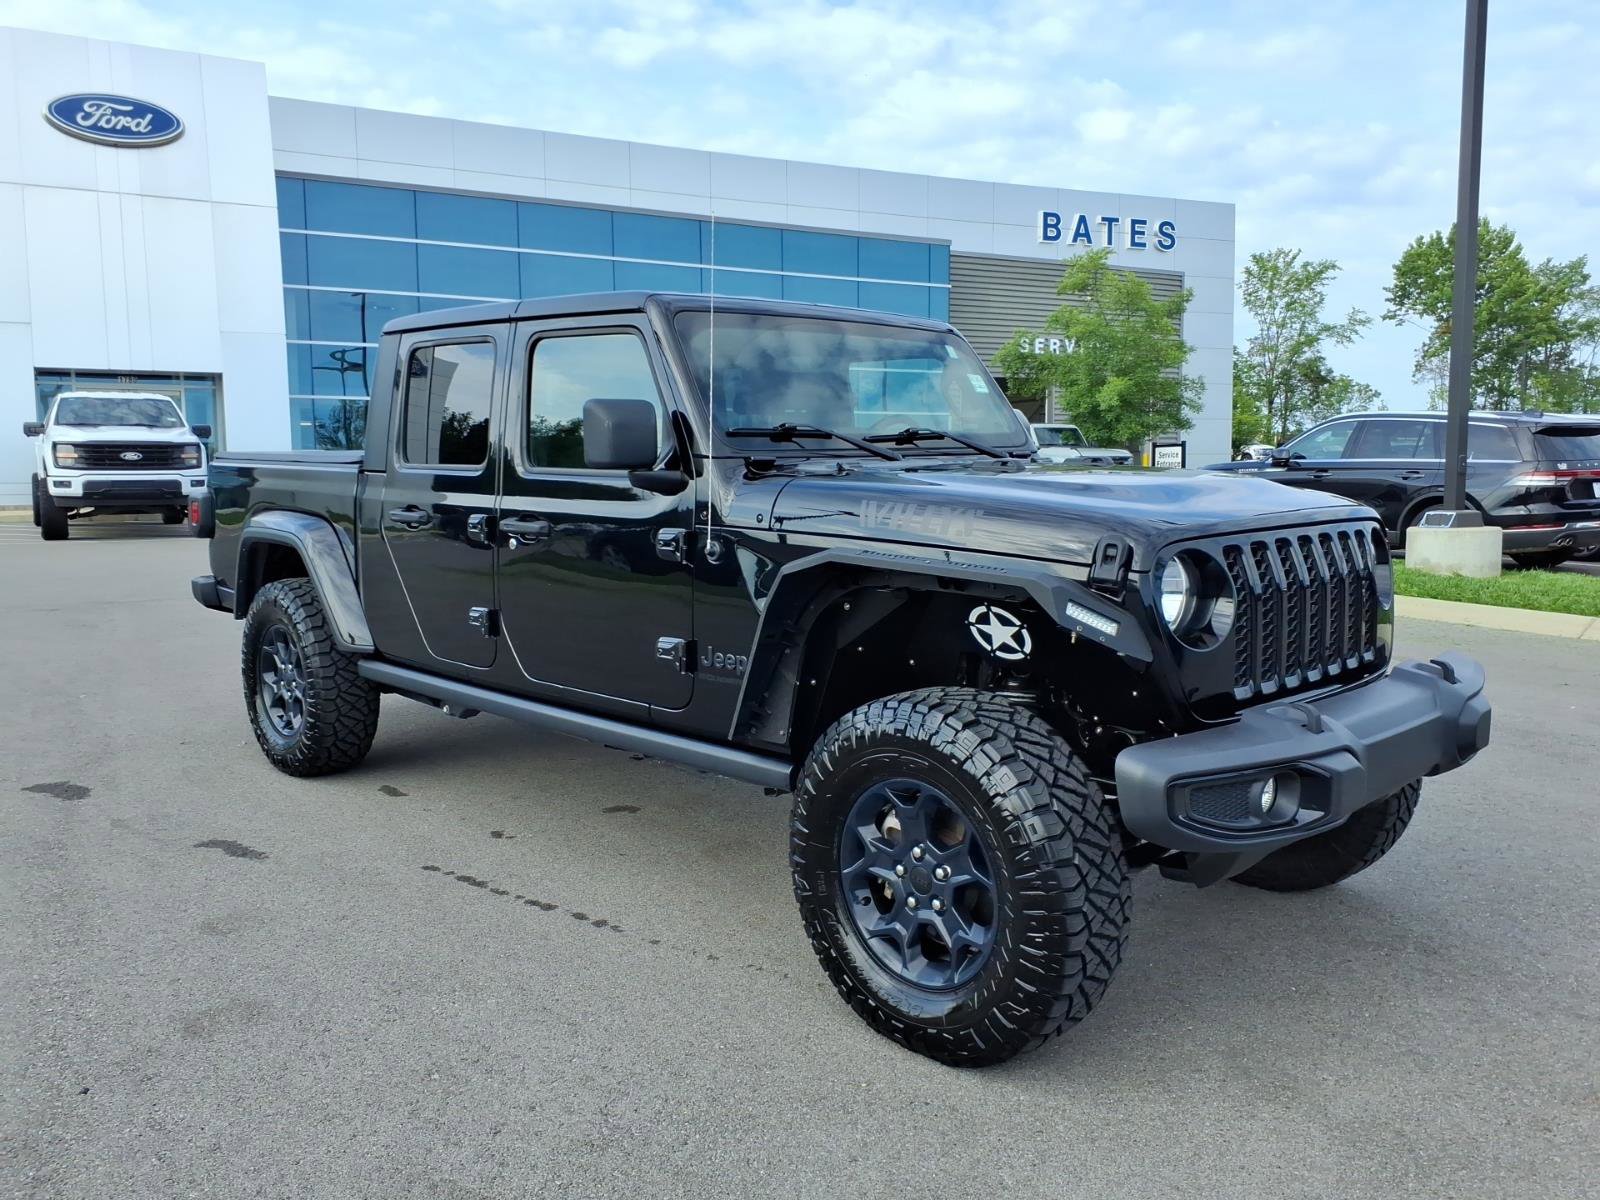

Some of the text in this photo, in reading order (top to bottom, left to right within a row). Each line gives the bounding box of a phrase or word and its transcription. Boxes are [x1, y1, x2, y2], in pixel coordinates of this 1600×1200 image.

[76, 100, 153, 133] Ford
[1039, 211, 1176, 251] BATES
[1020, 337, 1101, 355] SERV
[1158, 451, 1179, 459] Service
[700, 645, 748, 676] Jeep
